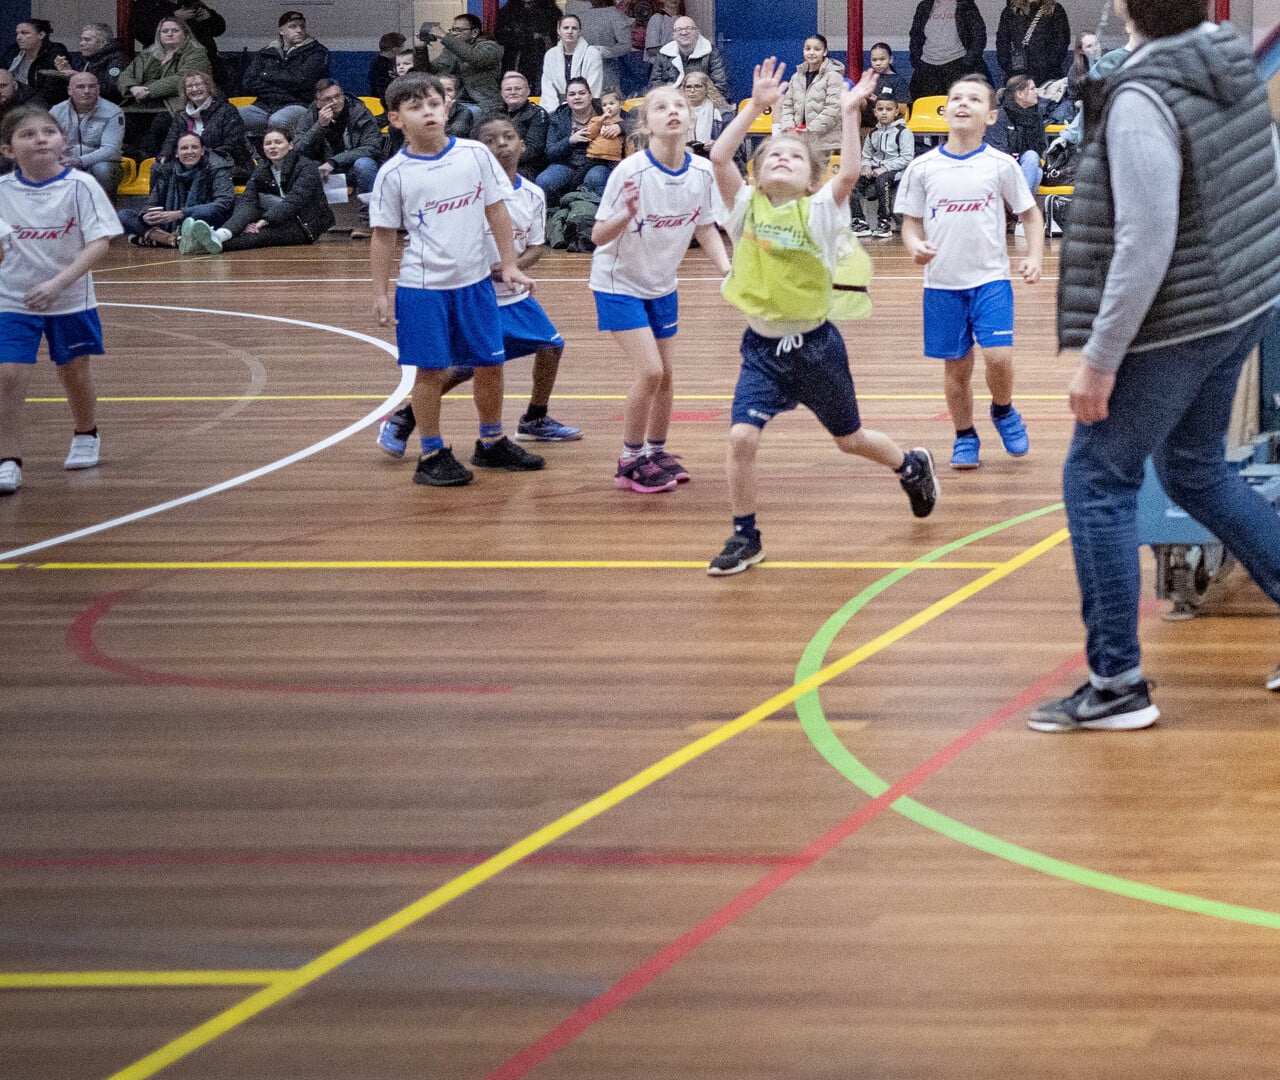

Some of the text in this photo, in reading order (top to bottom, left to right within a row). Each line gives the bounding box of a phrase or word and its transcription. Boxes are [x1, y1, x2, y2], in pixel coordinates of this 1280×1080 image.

[436, 196, 472, 214] DIJK
[945, 203, 982, 213] DIJK
[18, 231, 58, 240] DIJK
